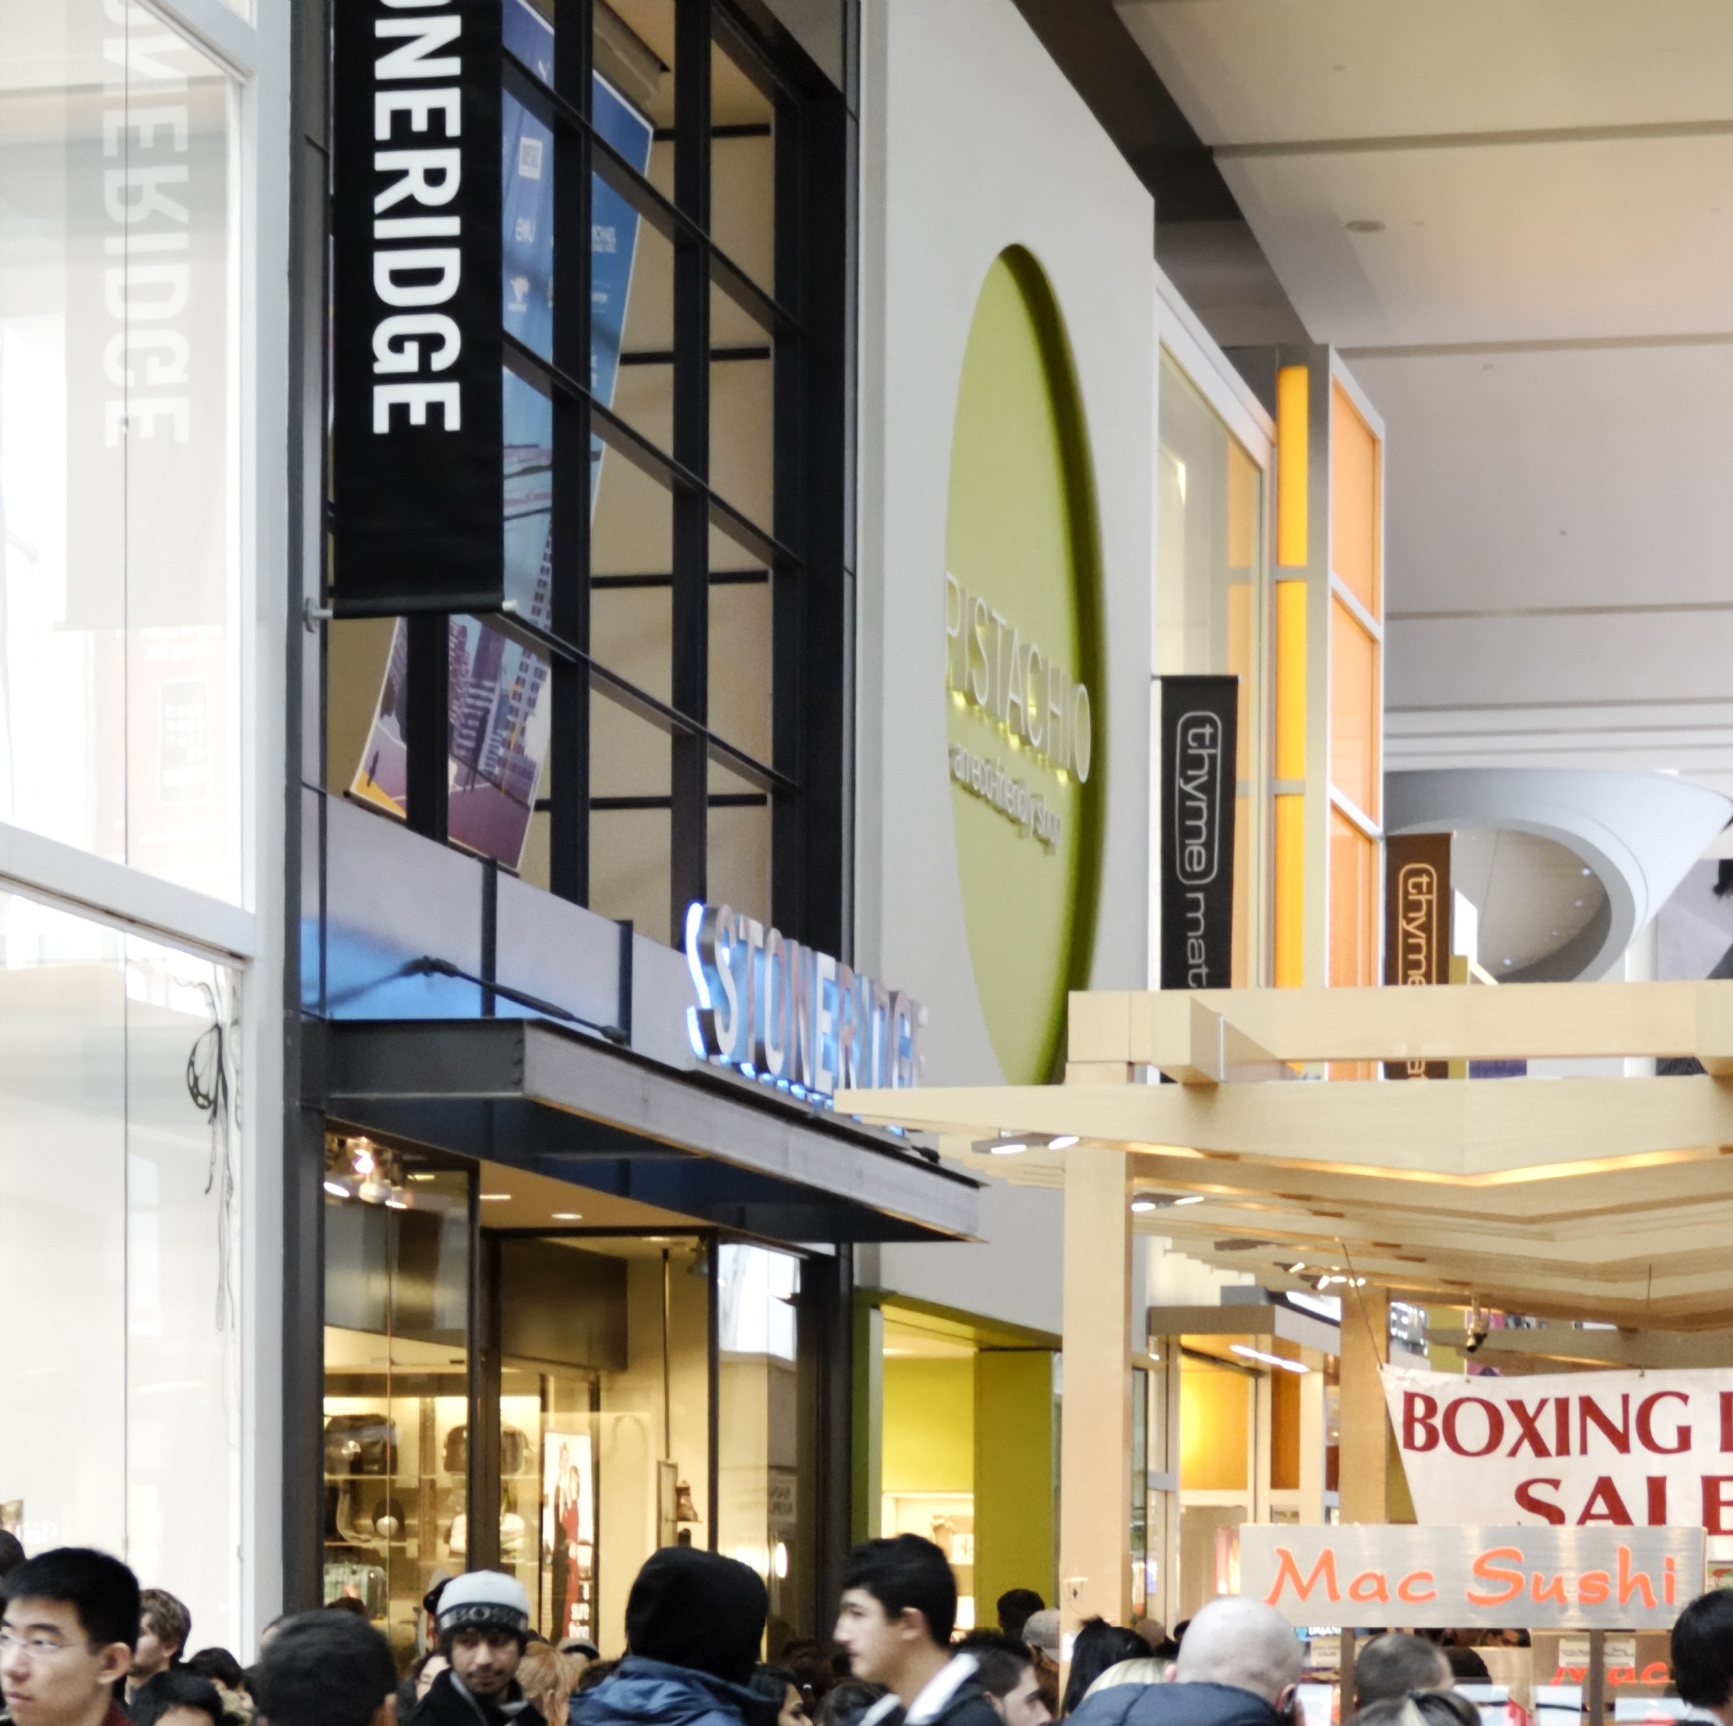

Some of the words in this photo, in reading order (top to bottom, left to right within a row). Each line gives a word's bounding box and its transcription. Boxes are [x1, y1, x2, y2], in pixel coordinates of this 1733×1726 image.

[373, 0, 463, 435] NERIDGE
[1179, 722, 1218, 875] thyme
[1401, 1387, 1693, 1459] BOXING
[1265, 1546, 1437, 1607] Mac
[1466, 1546, 1678, 1610] Sushi
